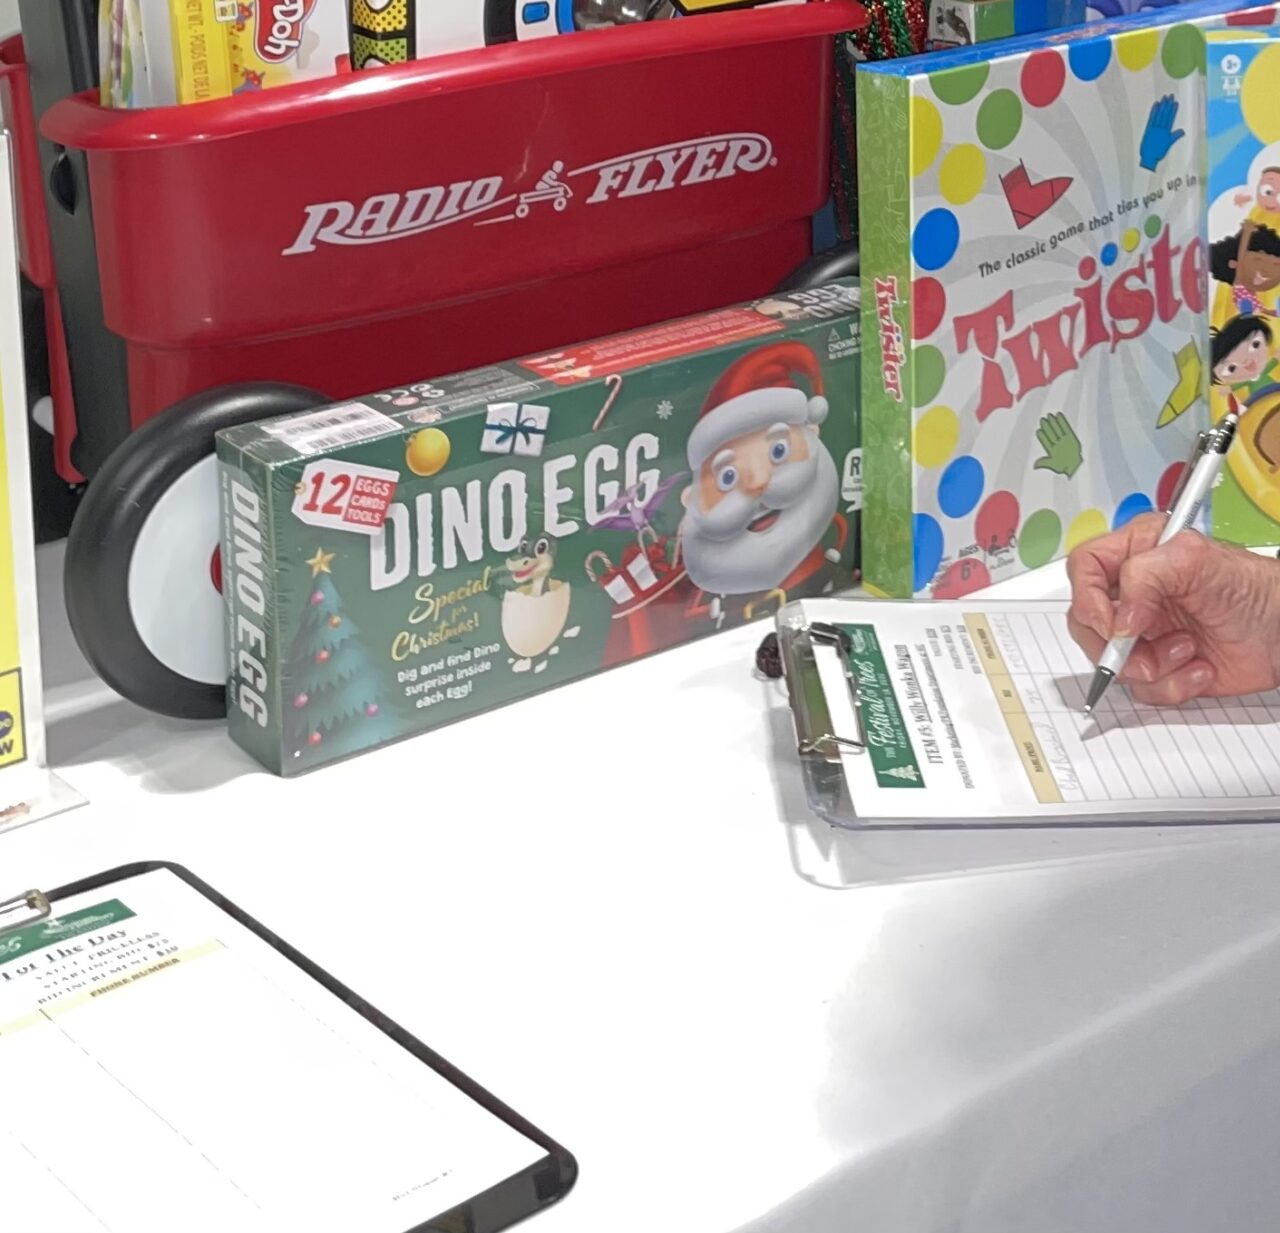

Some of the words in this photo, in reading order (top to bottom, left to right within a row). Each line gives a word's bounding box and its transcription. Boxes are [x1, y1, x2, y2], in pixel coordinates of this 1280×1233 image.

[281, 176, 504, 256] RADIO
[586, 133, 774, 205] FLYER
[978, 262, 1001, 279] The
[1006, 244, 1046, 269] classic
[1049, 221, 1085, 249] game
[1089, 213, 1114, 232] that
[1117, 199, 1139, 216] ties
[1142, 190, 1164, 209] you
[1167, 177, 1182, 192] up
[1185, 174, 1197, 187] in
[874, 275, 905, 402] Twister
[953, 224, 1209, 423] Twiste
[303, 471, 351, 515] 12
[350, 492, 387, 511] CARDS
[354, 477, 390, 497] EGGS
[346, 505, 383, 525] TOOLS
[370, 469, 529, 591] DINO
[543, 433, 661, 538] EGG
[231, 479, 266, 616] DINO
[407, 566, 492, 625] Special
[391, 612, 481, 662] Christmas!
[237, 624, 268, 728] EGG
[397, 661, 418, 684] Dig
[420, 658, 445, 677] and
[446, 649, 470, 671] find
[473, 641, 501, 663] Dino
[405, 672, 454, 696] surprise
[456, 660, 492, 683] inside
[854, 659, 879, 689] Trees
[415, 689, 444, 709] each
[446, 681, 473, 702] Egg!
[900, 671, 921, 699] Wonka
[861, 694, 896, 747] Festival
[909, 700, 932, 723] Willy
[922, 739, 943, 764] ITEM
[45, 945, 84, 964] The
[87, 929, 127, 948] Day
